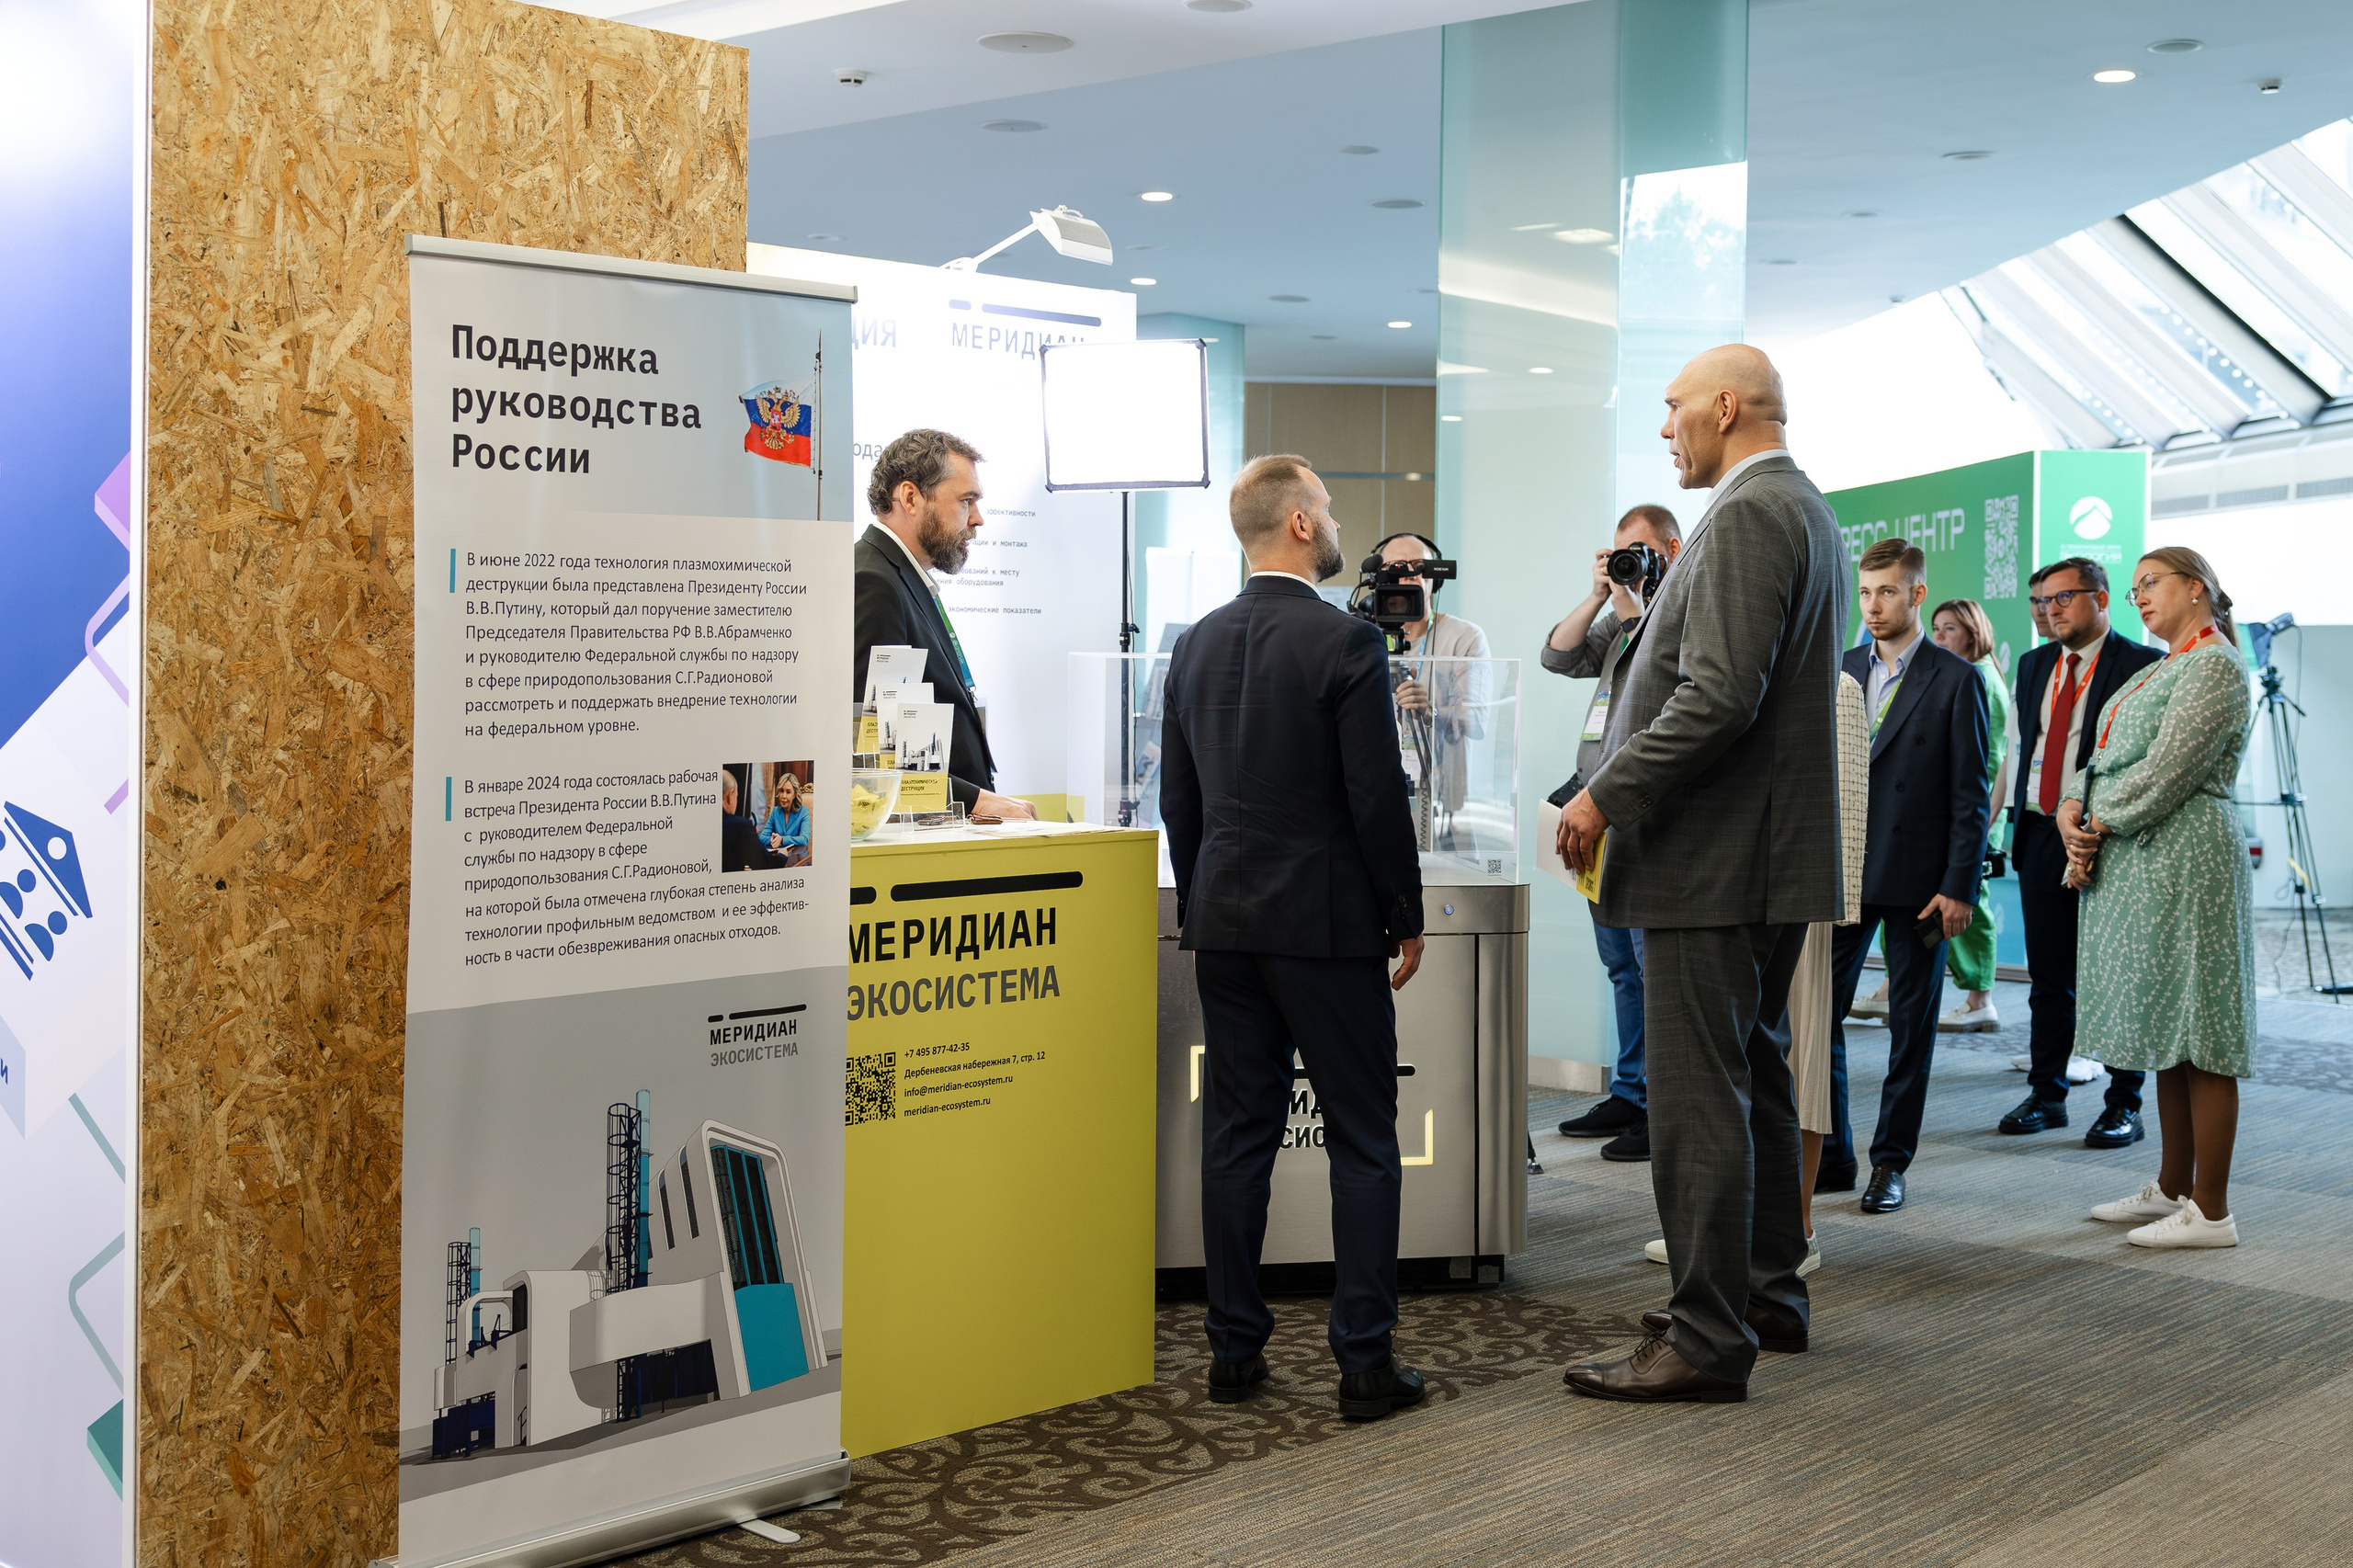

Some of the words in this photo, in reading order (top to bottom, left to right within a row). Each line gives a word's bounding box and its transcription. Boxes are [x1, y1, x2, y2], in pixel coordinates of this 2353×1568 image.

[452, 324, 659, 378] Поддержка
[952, 322, 1084, 360] МЕРИД
[452, 387, 702, 430] руководства
[452, 433, 590, 474] России
[467, 551, 476, 566] В
[480, 555, 521, 567] июне
[524, 552, 555, 568] 2022
[560, 557, 590, 571] года
[594, 558, 669, 570] технология
[673, 559, 791, 573] плазмохимической
[999, 569, 1020, 578] месту
[465, 579, 548, 595] деструкции
[552, 576, 589, 592] была
[593, 581, 684, 596] представлена
[688, 579, 764, 597] Президенту
[766, 581, 807, 595] России
[956, 577, 1005, 587] оборудования
[466, 600, 546, 619] В.В.Путину,
[551, 601, 609, 619] который
[612, 605, 638, 619] дал
[642, 605, 710, 619] поручение
[713, 606, 792, 617] заместителю
[948, 606, 1000, 615] экономические
[1002, 607, 1042, 615] показатели
[466, 625, 566, 642] Председателя
[570, 625, 669, 642] Правительства
[673, 624, 691, 639] РФ
[695, 624, 792, 642] В.В.Абрамченко
[465, 653, 474, 664] и
[479, 652, 581, 667] руководителю
[585, 647, 676, 665] Федеральной
[679, 647, 728, 665] службы
[731, 651, 748, 661] по
[751, 650, 800, 664] надзору
[465, 676, 473, 688] в
[478, 673, 521, 691] сфере
[524, 674, 672, 690] природопользования
[675, 669, 773, 687] С.Г.Радионовой
[465, 699, 554, 716] рассмотреть
[558, 699, 567, 710] и
[571, 697, 654, 712] поддержать
[657, 695, 727, 710] внедрение
[729, 694, 797, 706] технологии
[465, 725, 483, 736] на
[487, 721, 585, 740] федеральном
[587, 721, 640, 736] уровне.
[464, 779, 474, 794] В
[477, 779, 524, 795] январе
[527, 775, 561, 790] 2024
[563, 777, 593, 791] года
[596, 774, 666, 788] состоялась
[668, 768, 718, 788] рабочая
[464, 804, 516, 821] встреча
[518, 800, 599, 818] Президента
[603, 796, 647, 811] России
[650, 792, 717, 809] В.В.Путина
[463, 831, 472, 843] с
[479, 824, 583, 846] руководителем
[585, 815, 673, 836] Федеральной
[464, 848, 516, 869] службы
[518, 851, 537, 863] по
[540, 846, 596, 863] надзору
[598, 846, 606, 858] в
[608, 841, 648, 859] сфере
[464, 869, 608, 894] природопользования
[611, 858, 712, 880] С.Г.Радионовой,
[465, 905, 483, 918] на
[485, 896, 540, 916] которой
[544, 895, 580, 911] была
[583, 892, 646, 907] отмечена
[650, 885, 705, 903] глубокая
[708, 882, 756, 897] степень
[759, 878, 805, 892] анализа
[464, 924, 542, 942] технологии
[546, 915, 635, 937] профильным
[638, 908, 716, 927] ведомством
[722, 907, 730, 917] и
[732, 905, 747, 916] ее
[749, 900, 810, 917] эффектив-
[465, 951, 501, 966] ность
[504, 949, 513, 961] в
[516, 946, 554, 960] части
[558, 935, 670, 956] обезвреживания
[673, 929, 726, 945] опасных
[728, 925, 781, 939] отходов.
[848, 906, 1057, 964] МЕРИДИАН
[847, 965, 1061, 1021] ЭКОСИСТЕМА
[710, 1018, 797, 1046] МЕРИДИАН
[710, 1041, 799, 1067] ЭКОСИСТЕМА
[904, 1049, 915, 1059] +7
[915, 1047, 931, 1057] 495
[931, 1041, 971, 1055] 877-42-35
[904, 1063, 961, 1081] Дербеневская
[962, 1057, 1011, 1071] набережная
[1011, 1054, 1019, 1065] 7,
[1020, 1054, 1035, 1063] стр.
[1036, 1051, 1046, 1061] 12
[904, 1075, 1014, 1097] info@meridian-ecosystem.ru
[904, 1097, 991, 1118] meridian-ecosystem.ru
